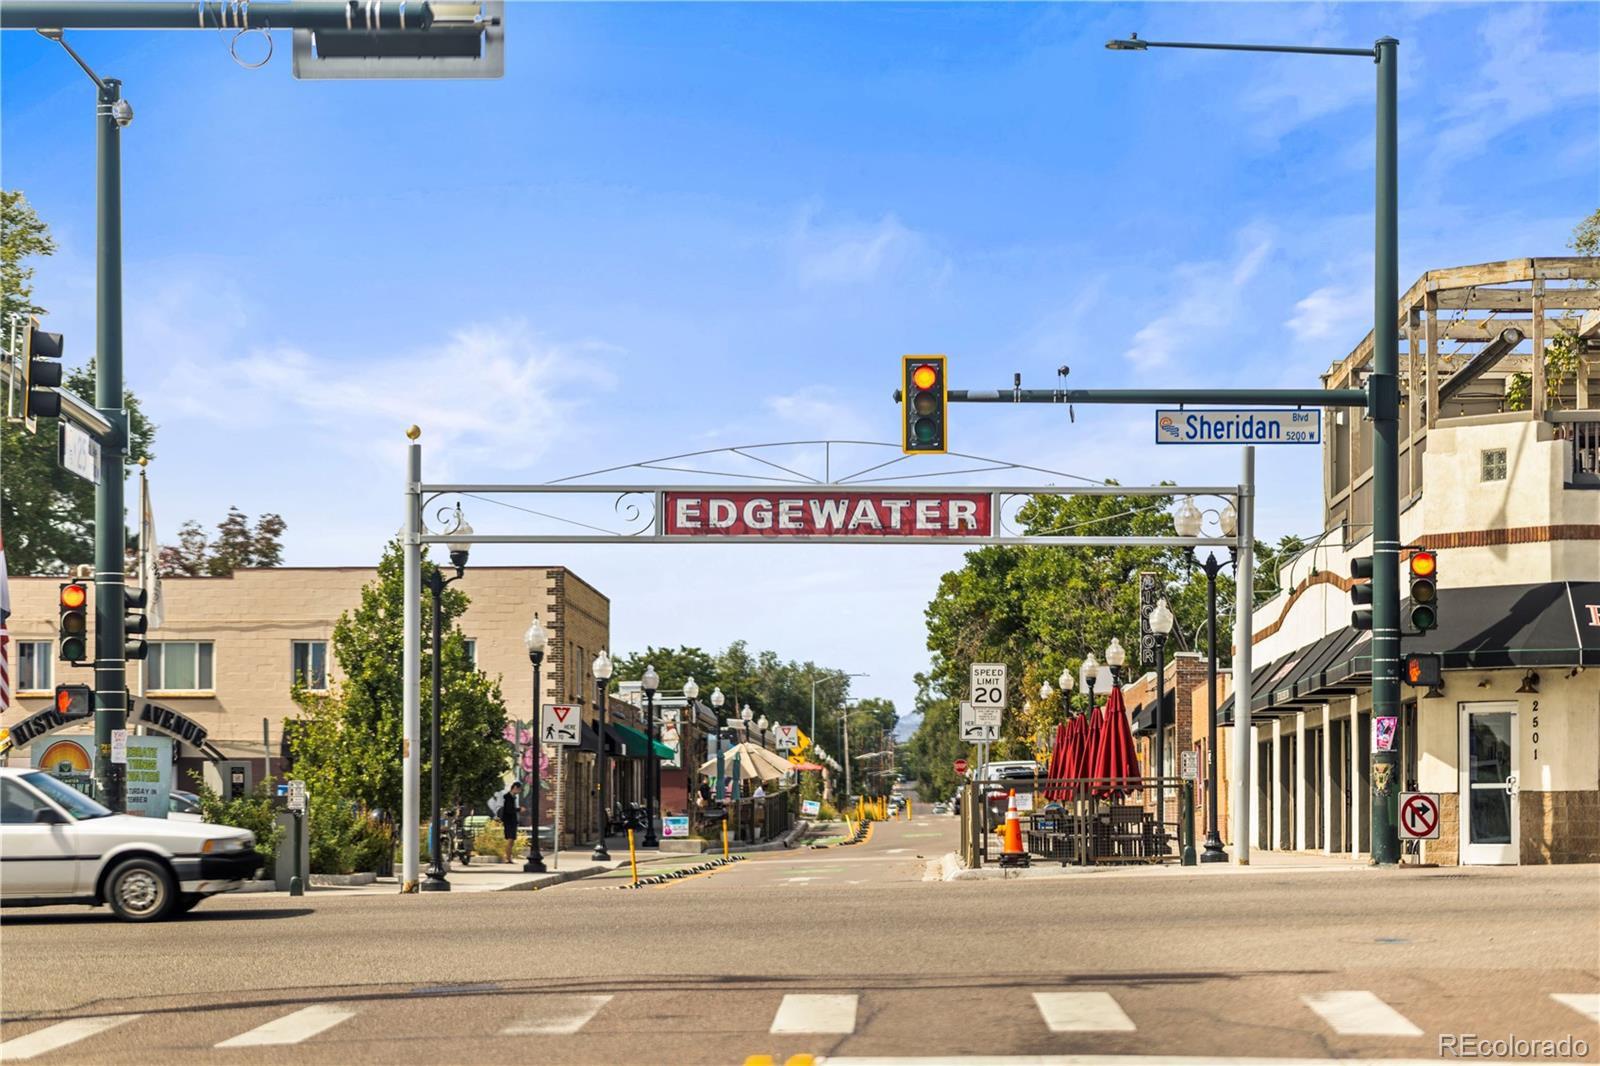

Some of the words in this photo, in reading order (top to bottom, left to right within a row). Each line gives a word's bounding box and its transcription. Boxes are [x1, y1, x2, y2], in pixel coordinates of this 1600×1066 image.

[1185, 414, 1281, 440] Sheridan
[1292, 413, 1309, 422] Blvd
[1286, 431, 1306, 441] 5200
[1309, 432, 1315, 440] W
[675, 497, 979, 530] EDGEWATER
[974, 669, 1004, 677] SPEED
[974, 687, 1002, 703] 20
[11, 709, 84, 747] HISTO
[140, 703, 208, 748] AVENUE
[127, 787, 150, 795] TURDAY
[127, 796, 148, 804] TEMBER
